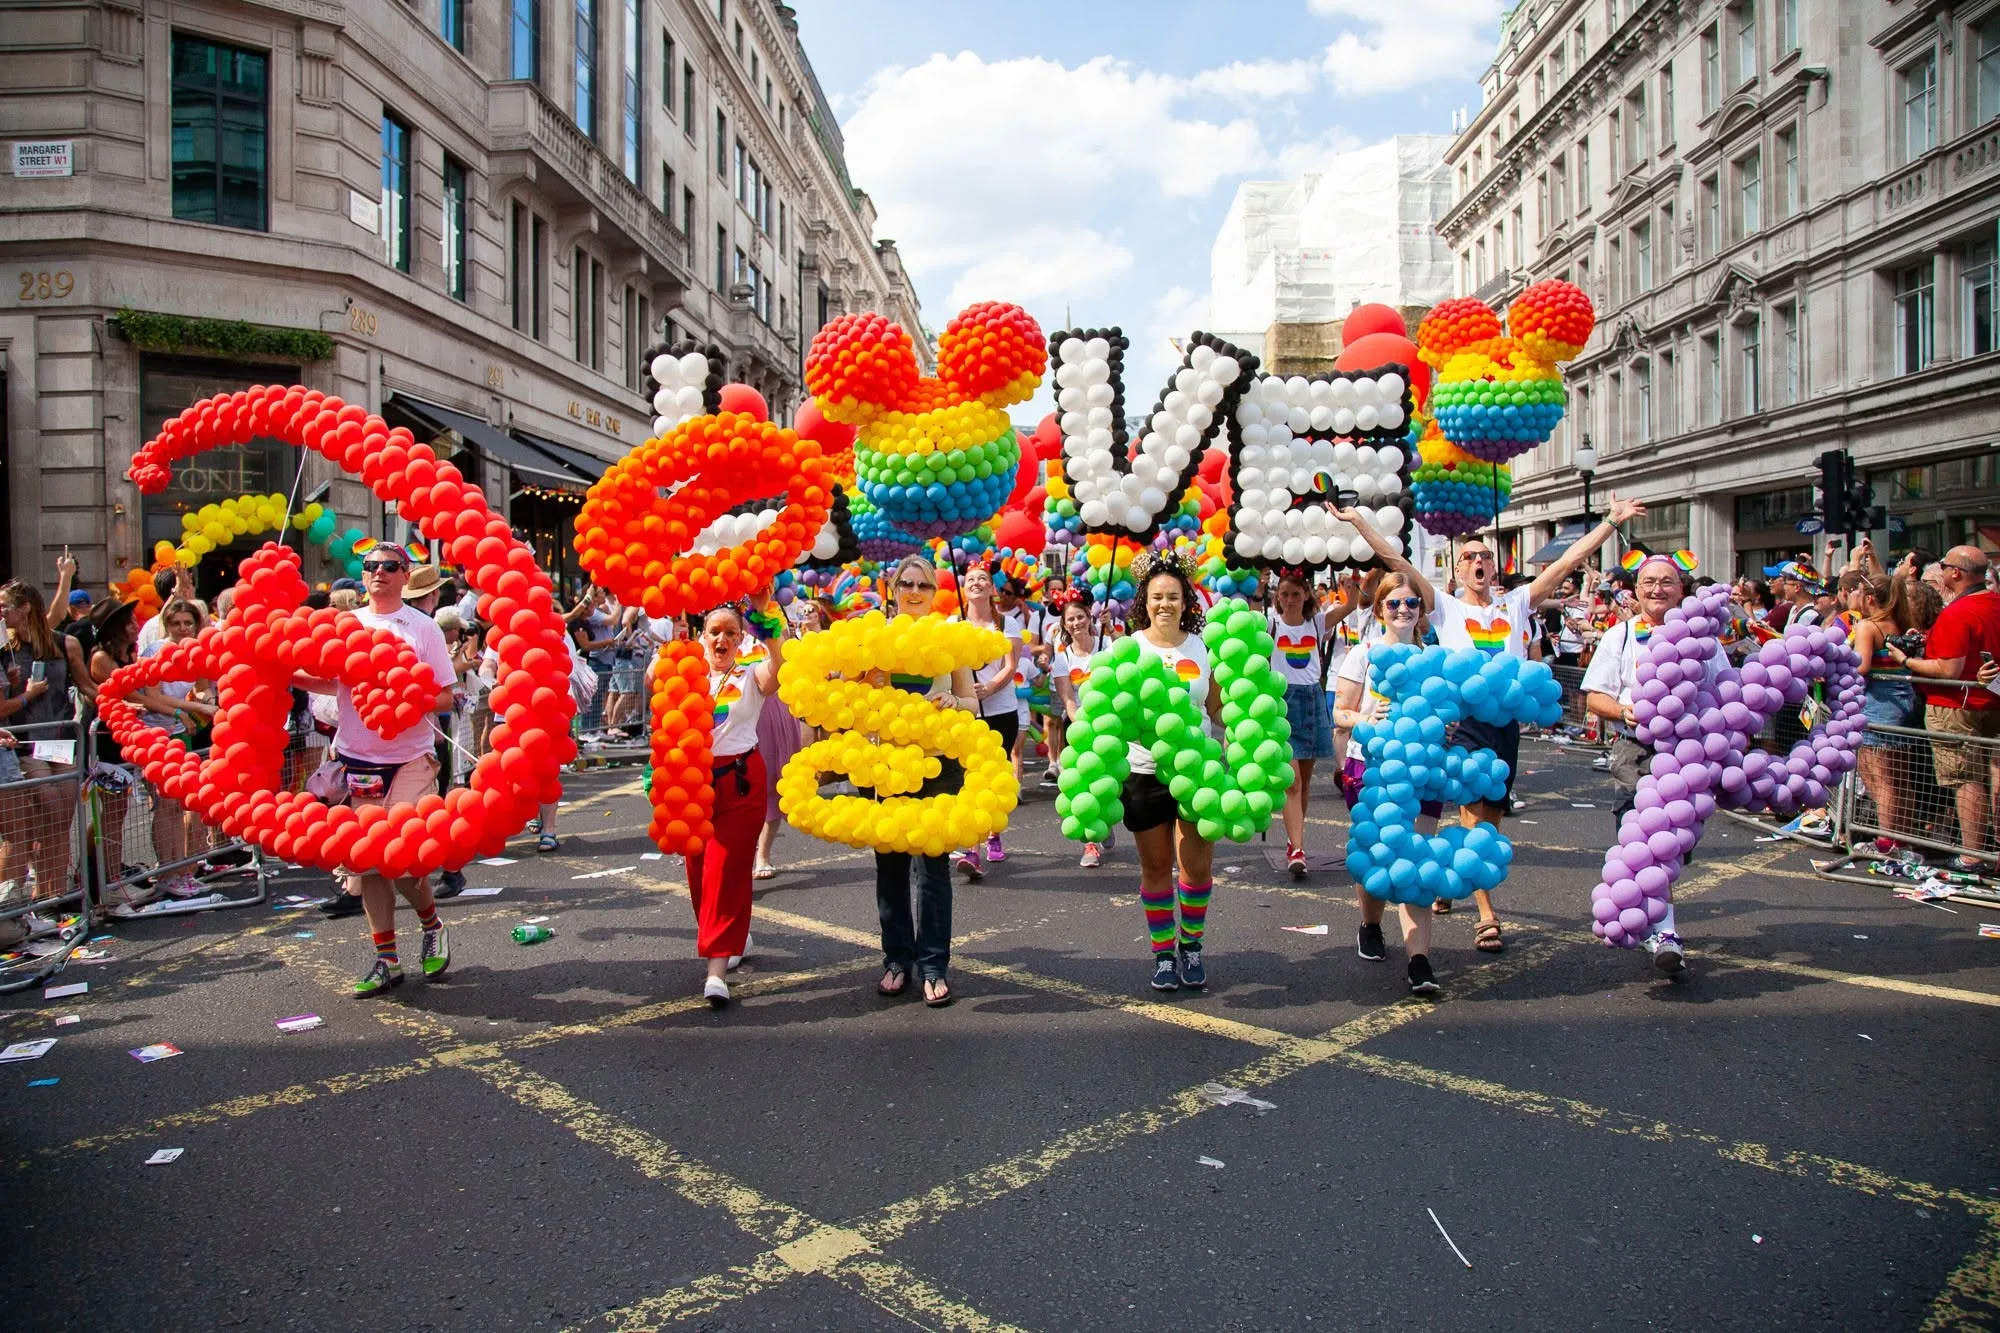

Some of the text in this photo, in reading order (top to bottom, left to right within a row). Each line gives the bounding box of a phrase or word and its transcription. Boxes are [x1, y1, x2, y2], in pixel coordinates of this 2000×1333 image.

[19, 145, 66, 154] MARGARET
[19, 156, 67, 166] STREET W1
[19, 271, 74, 300] 289
[351, 307, 377, 336] 289
[179, 467, 254, 493] ONE
